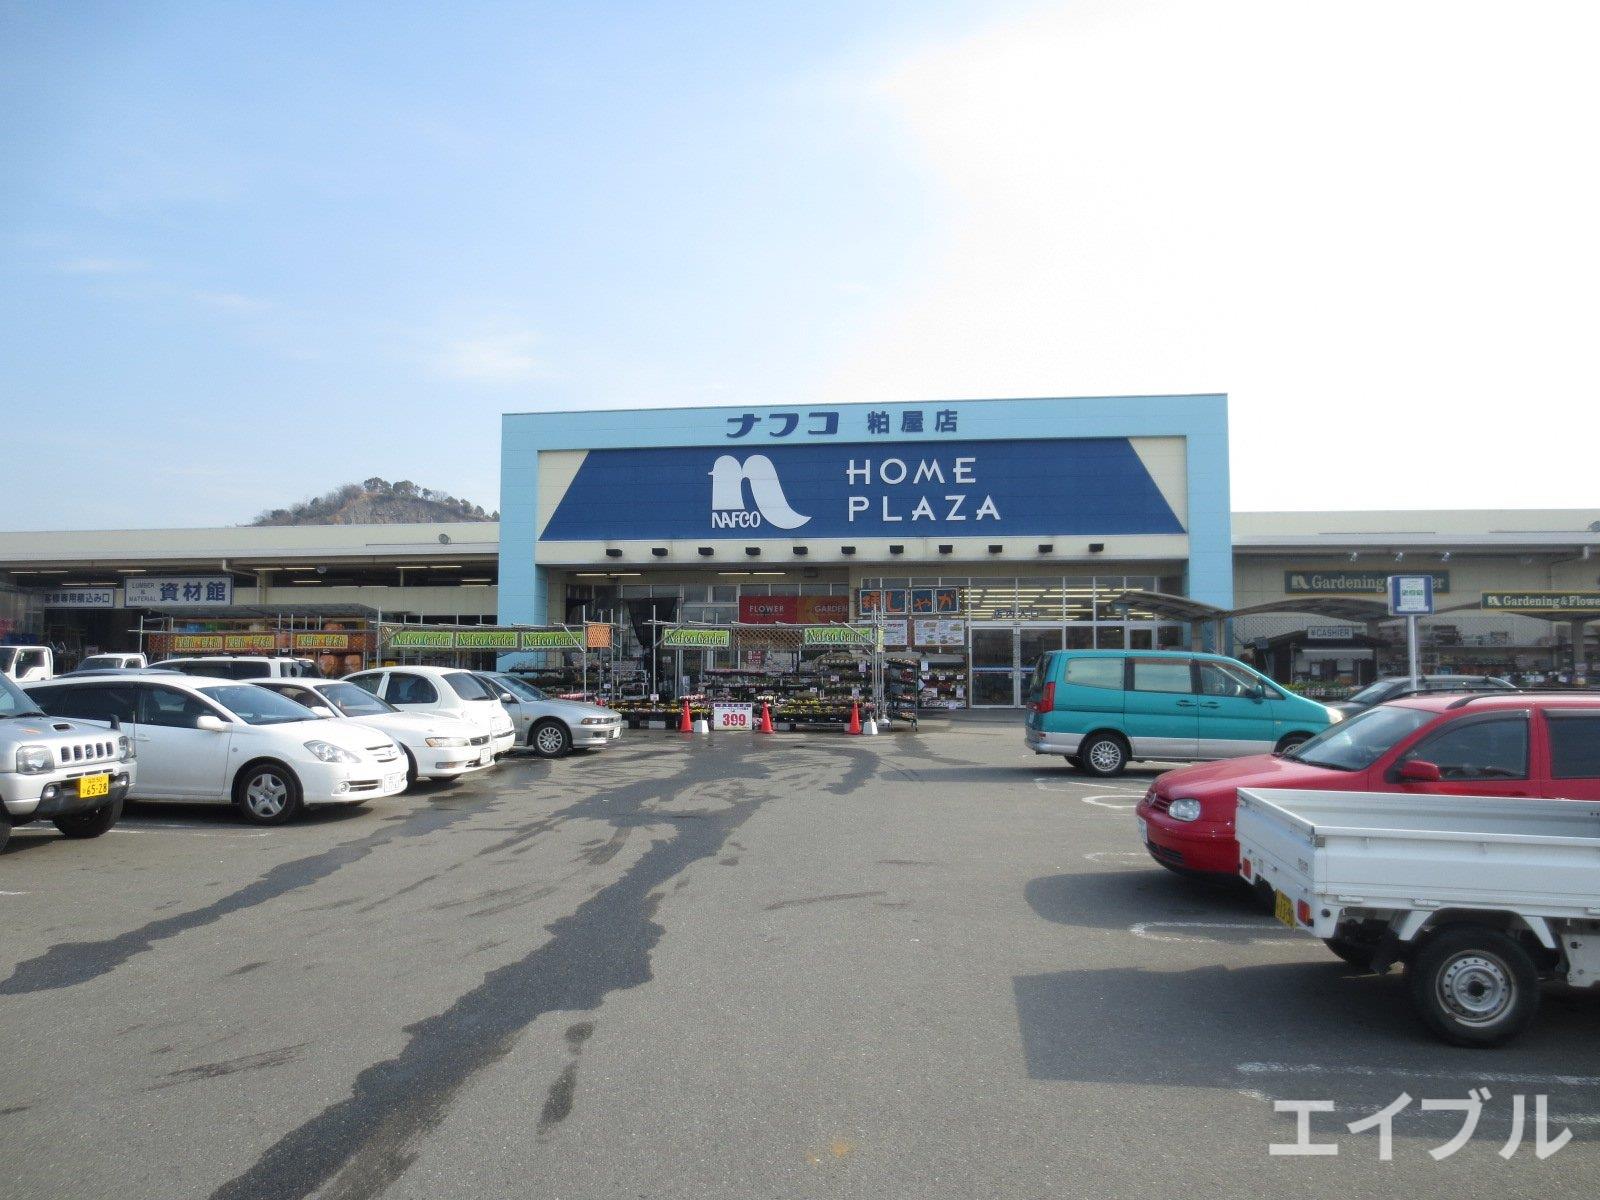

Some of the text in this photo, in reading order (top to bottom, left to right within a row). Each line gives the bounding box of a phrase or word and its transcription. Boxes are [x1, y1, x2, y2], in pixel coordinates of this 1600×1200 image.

[726, 409, 958, 438] ナフコ 粕屋店
[846, 457, 977, 485] HOME
[848, 494, 1002, 522] PLAZA
[711, 510, 761, 529] NAFCO
[1311, 574, 1385, 592] Gardening
[159, 581, 226, 602] 資材館
[749, 605, 848, 613] FLOWER GARDEN
[395, 633, 451, 645] Nafco Garden
[459, 633, 515, 645] Nafco Garden
[524, 633, 552, 645] Nafco
[667, 630, 726, 645] Nafco Garden
[808, 630, 836, 643] Nafco
[722, 713, 747, 726] 399
[86, 783, 107, 794] 65-28
